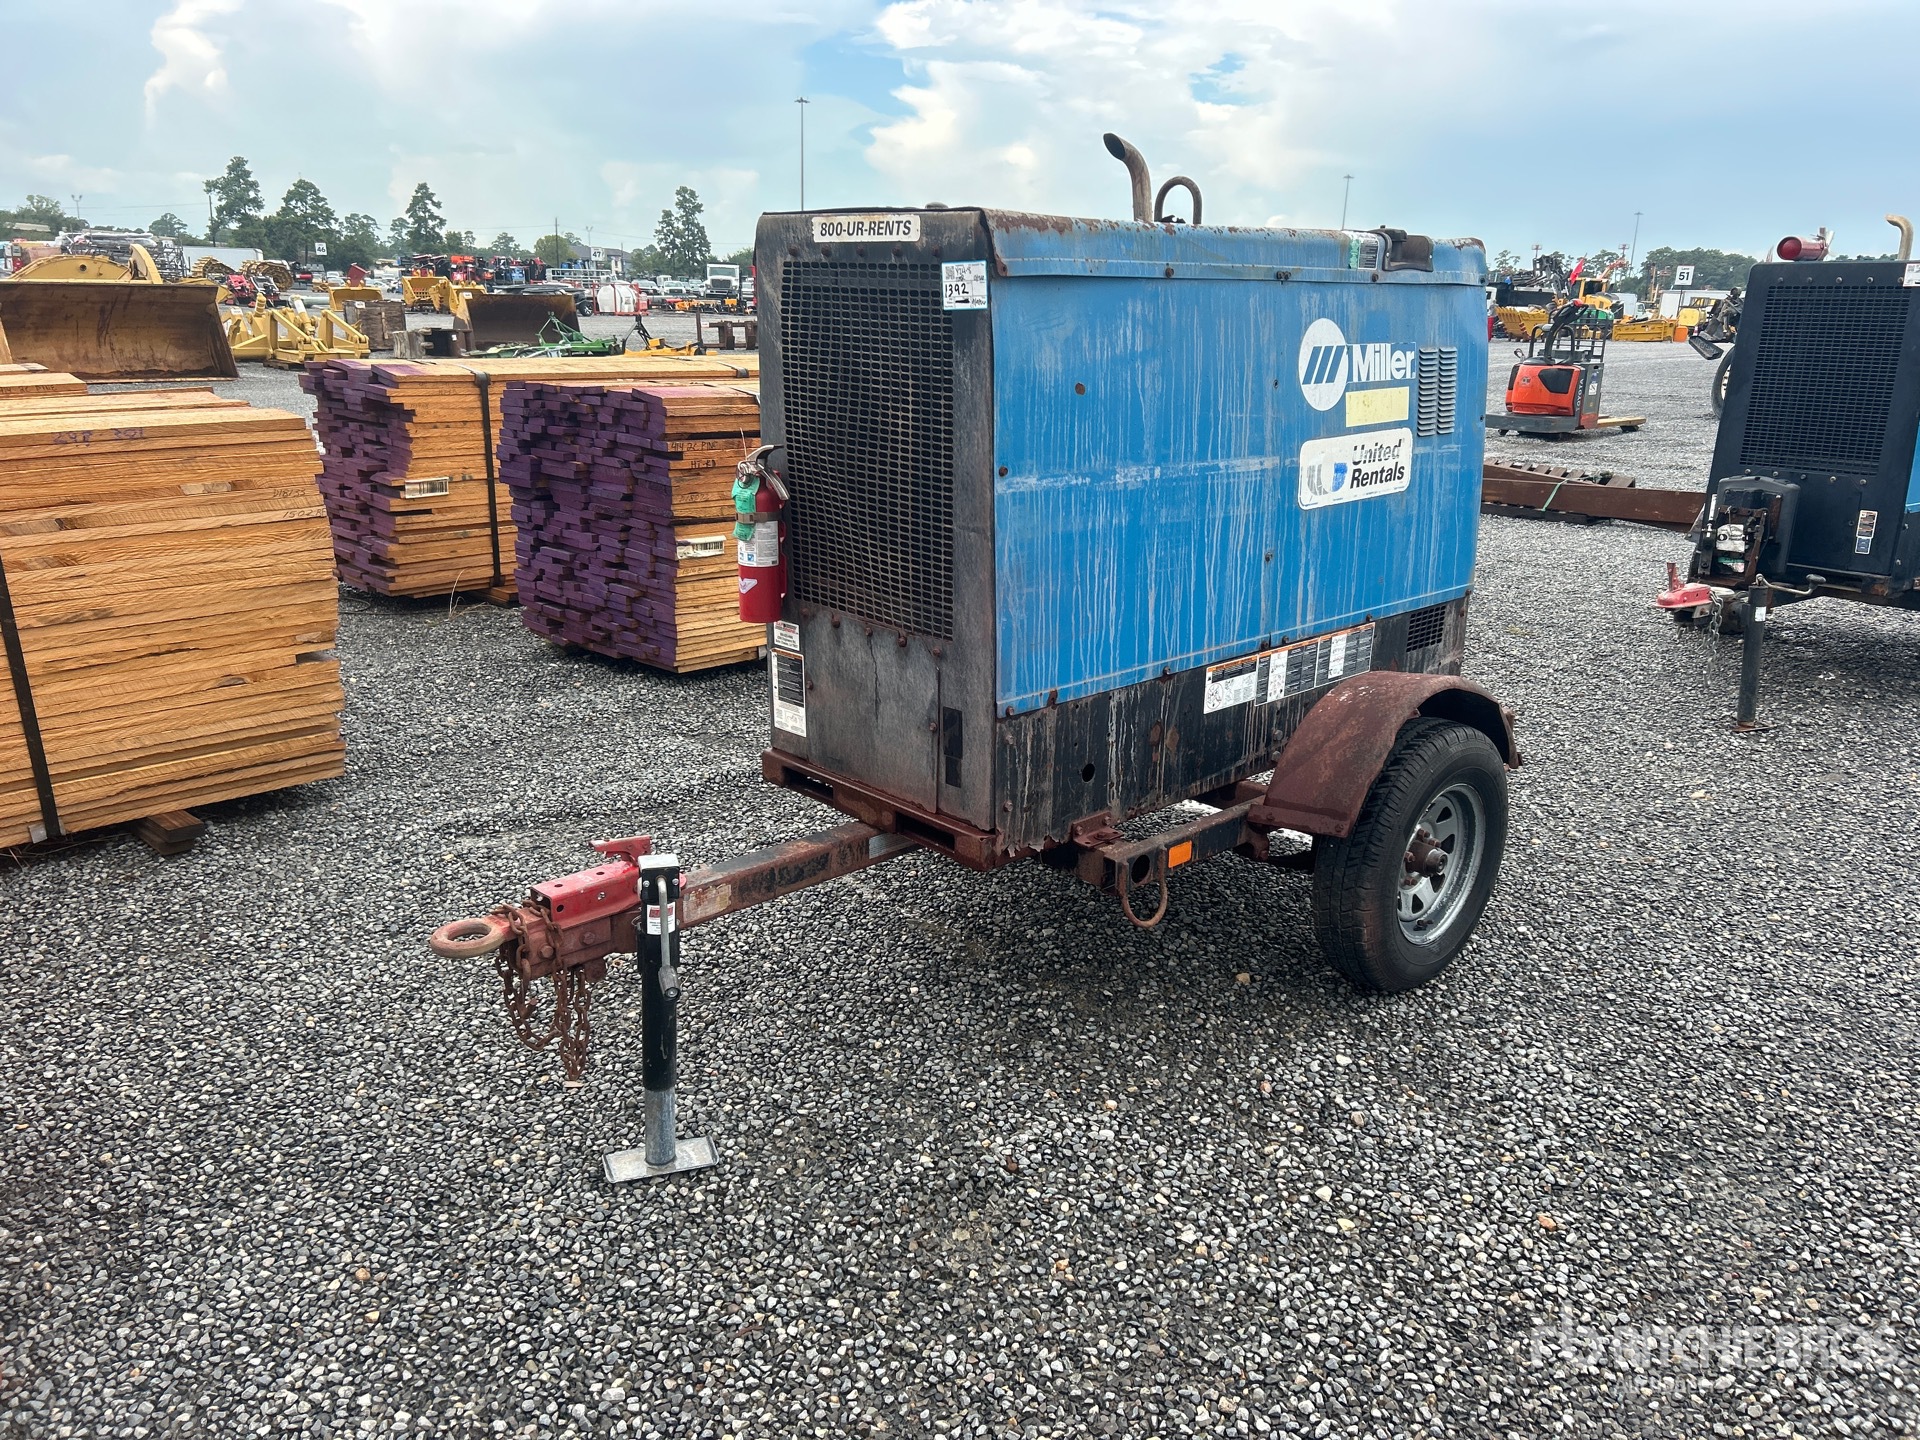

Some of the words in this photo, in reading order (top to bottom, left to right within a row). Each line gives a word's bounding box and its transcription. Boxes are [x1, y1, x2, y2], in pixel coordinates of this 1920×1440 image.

[820, 220, 912, 237] 800-UR-RENTS
[1678, 271, 1690, 281] 51
[945, 283, 969, 298] 1392
[1352, 343, 1415, 382] Miller
[1575, 378, 1584, 412] TOYOTA
[1352, 438, 1402, 466] United
[1349, 461, 1405, 489] Rentals
